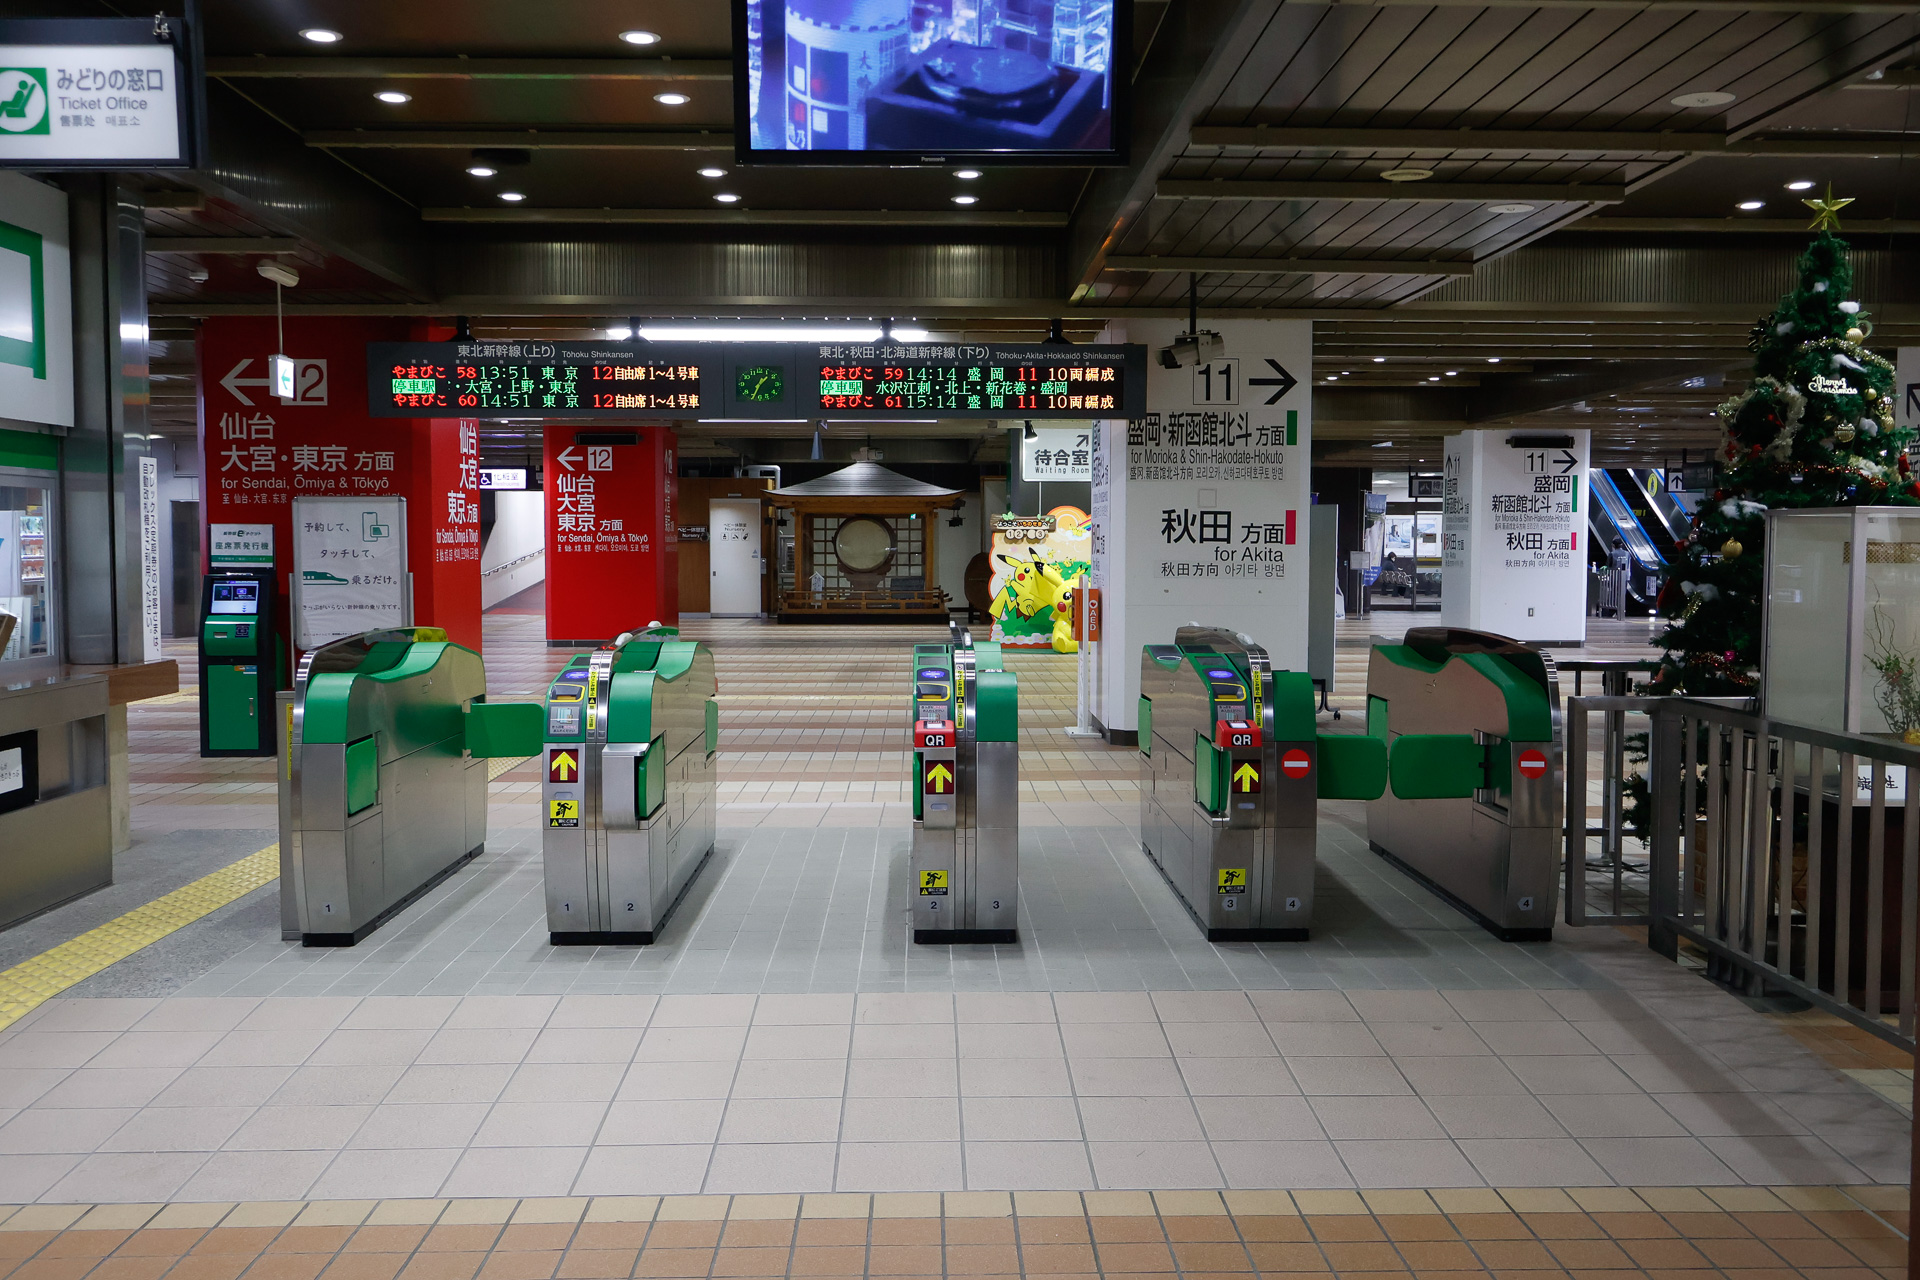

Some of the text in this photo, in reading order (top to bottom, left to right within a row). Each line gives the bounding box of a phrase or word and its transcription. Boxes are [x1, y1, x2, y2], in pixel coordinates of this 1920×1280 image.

[57, 68, 163, 91] みどりの窓口
[58, 97, 147, 110] Ticket Office
[106, 115, 140, 127] 매표소
[458, 345, 555, 358] 東北新幹線（上り）
[591, 350, 634, 359] Shinkansen
[1083, 352, 1124, 360] Shinkansen
[392, 365, 446, 379] やまびこ
[457, 366, 477, 379] 58
[480, 366, 530, 380] 13:51
[593, 366, 613, 380] 12
[821, 366, 874, 380] やまびこ
[884, 367, 903, 380] 59
[907, 367, 956, 381] 14:14
[1018, 367, 1037, 381] 11
[393, 380, 434, 393] 停車駅
[821, 380, 862, 394] 停車駅
[1198, 364, 1231, 401] 11
[1808, 381, 1857, 394] Christmas
[1812, 374, 1846, 388] Merry
[393, 394, 447, 407] やまびこ
[458, 394, 477, 407] 60
[481, 394, 530, 408] 14:51
[593, 394, 614, 408] 12
[821, 395, 874, 408] やまびこ
[885, 395, 902, 408] 61
[907, 395, 956, 409] 15:14
[1018, 395, 1037, 409] 11
[219, 412, 276, 440] 仙台
[460, 421, 477, 456] 仙台
[1256, 425, 1285, 447] 方面
[221, 444, 394, 472] 大宮・東京 方面
[589, 449, 612, 470] 12
[1034, 449, 1089, 466] 待合室
[1131, 449, 1283, 465] for Morioka & Shin-Hakodate-Hokuto
[1527, 453, 1545, 472] 11
[459, 456, 477, 490] 大宮
[1035, 466, 1066, 475] Waiting
[221, 477, 238, 489] for
[242, 477, 290, 490] Sendai,
[339, 477, 348, 489] &
[352, 476, 389, 491] Tōkyō
[556, 473, 595, 492] 仙台
[1534, 475, 1570, 493] 盛岡
[447, 490, 466, 525] 東京
[556, 493, 595, 512] 大宮
[1492, 494, 1570, 513] 新函館北斗 方面
[304, 522, 350, 532] 予約して、
[557, 513, 623, 532] 東京 方面
[1161, 508, 1284, 545] 秋田 方面
[557, 534, 567, 542] for
[621, 534, 626, 542] &
[1506, 532, 1569, 551] 秋田 方面
[320, 549, 375, 559] タッチして、
[1214, 546, 1283, 562] for Akita
[1533, 551, 1569, 560] for Akita
[1161, 562, 1219, 577] 秋田方向
[1224, 563, 1285, 578] 아키타 방면
[351, 575, 398, 586] 乗るだけ。
[925, 734, 945, 746] QR
[1232, 734, 1252, 746] QR
[326, 904, 331, 913] 1
[564, 903, 570, 912] 1
[627, 903, 634, 912] 2
[930, 901, 937, 910] 2
[992, 900, 1000, 910] 3
[1227, 900, 1234, 908] 3
[1289, 900, 1296, 908] 4
[1523, 899, 1530, 908] 4
